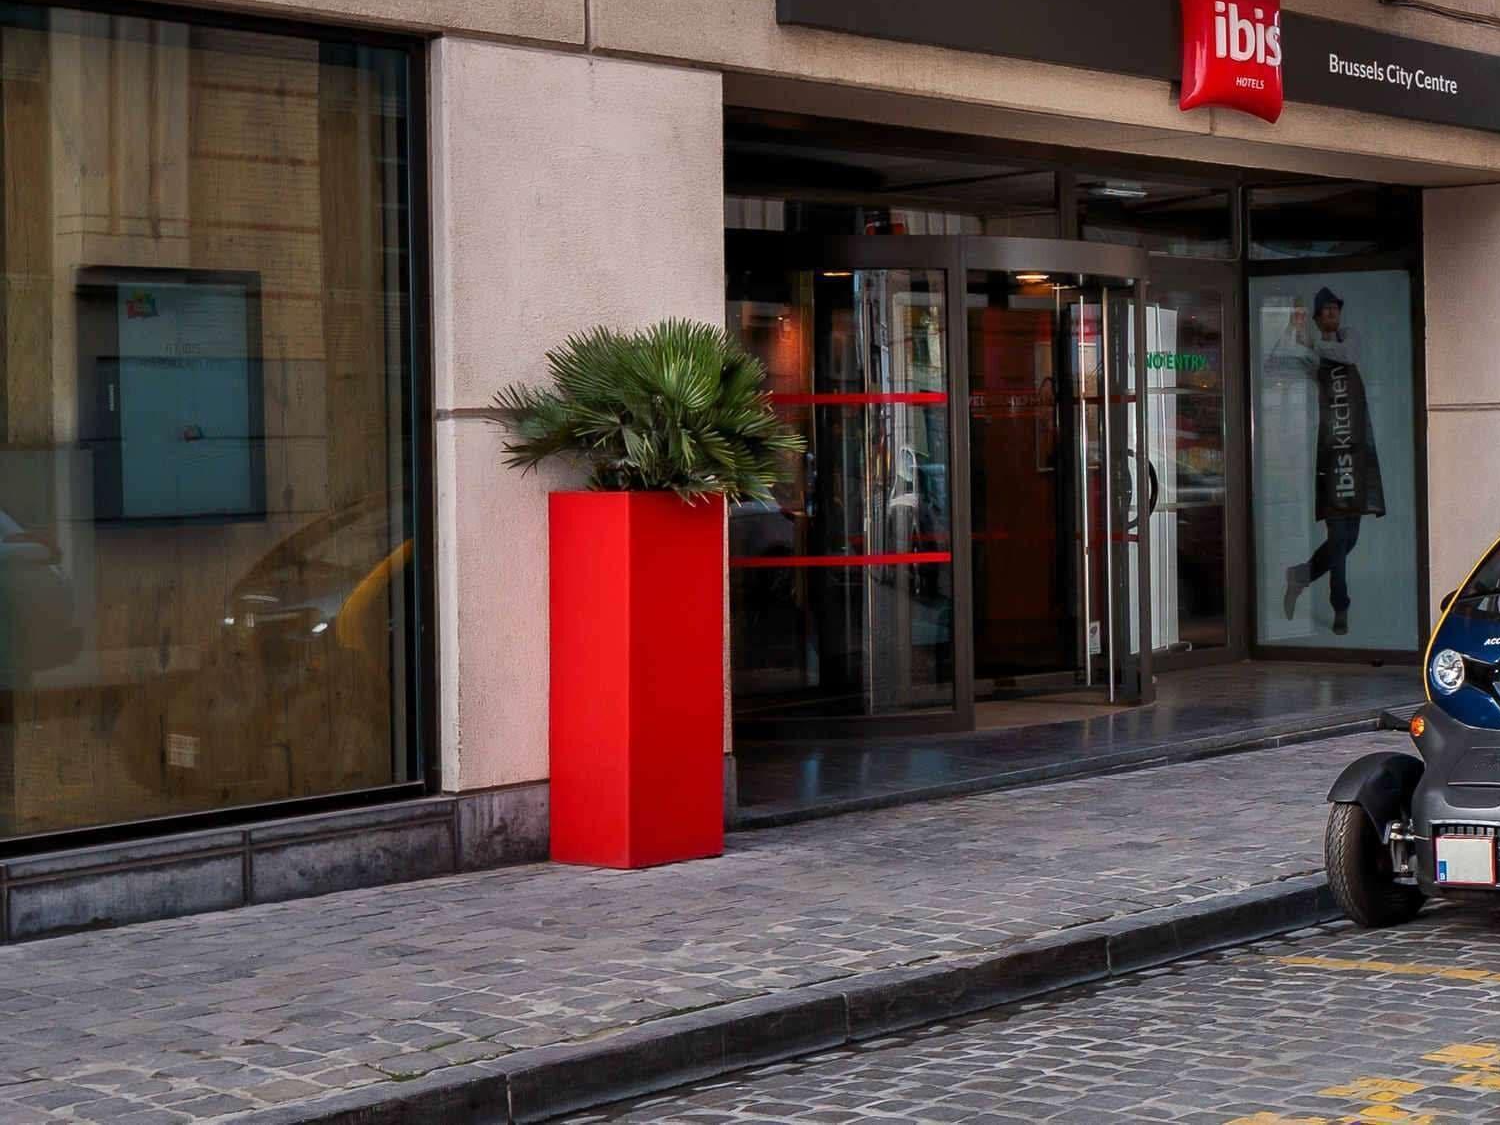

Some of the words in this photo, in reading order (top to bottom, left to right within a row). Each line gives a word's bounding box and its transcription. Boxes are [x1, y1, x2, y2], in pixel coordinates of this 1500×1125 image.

[1215, 0, 1281, 66] ibis
[1236, 77, 1265, 89] HOTELS
[1329, 54, 1384, 81] Brussels
[1386, 64, 1412, 89] City
[1415, 70, 1457, 94] Centre
[1330, 365, 1352, 449] kitchen
[1334, 454, 1355, 497] ibis
